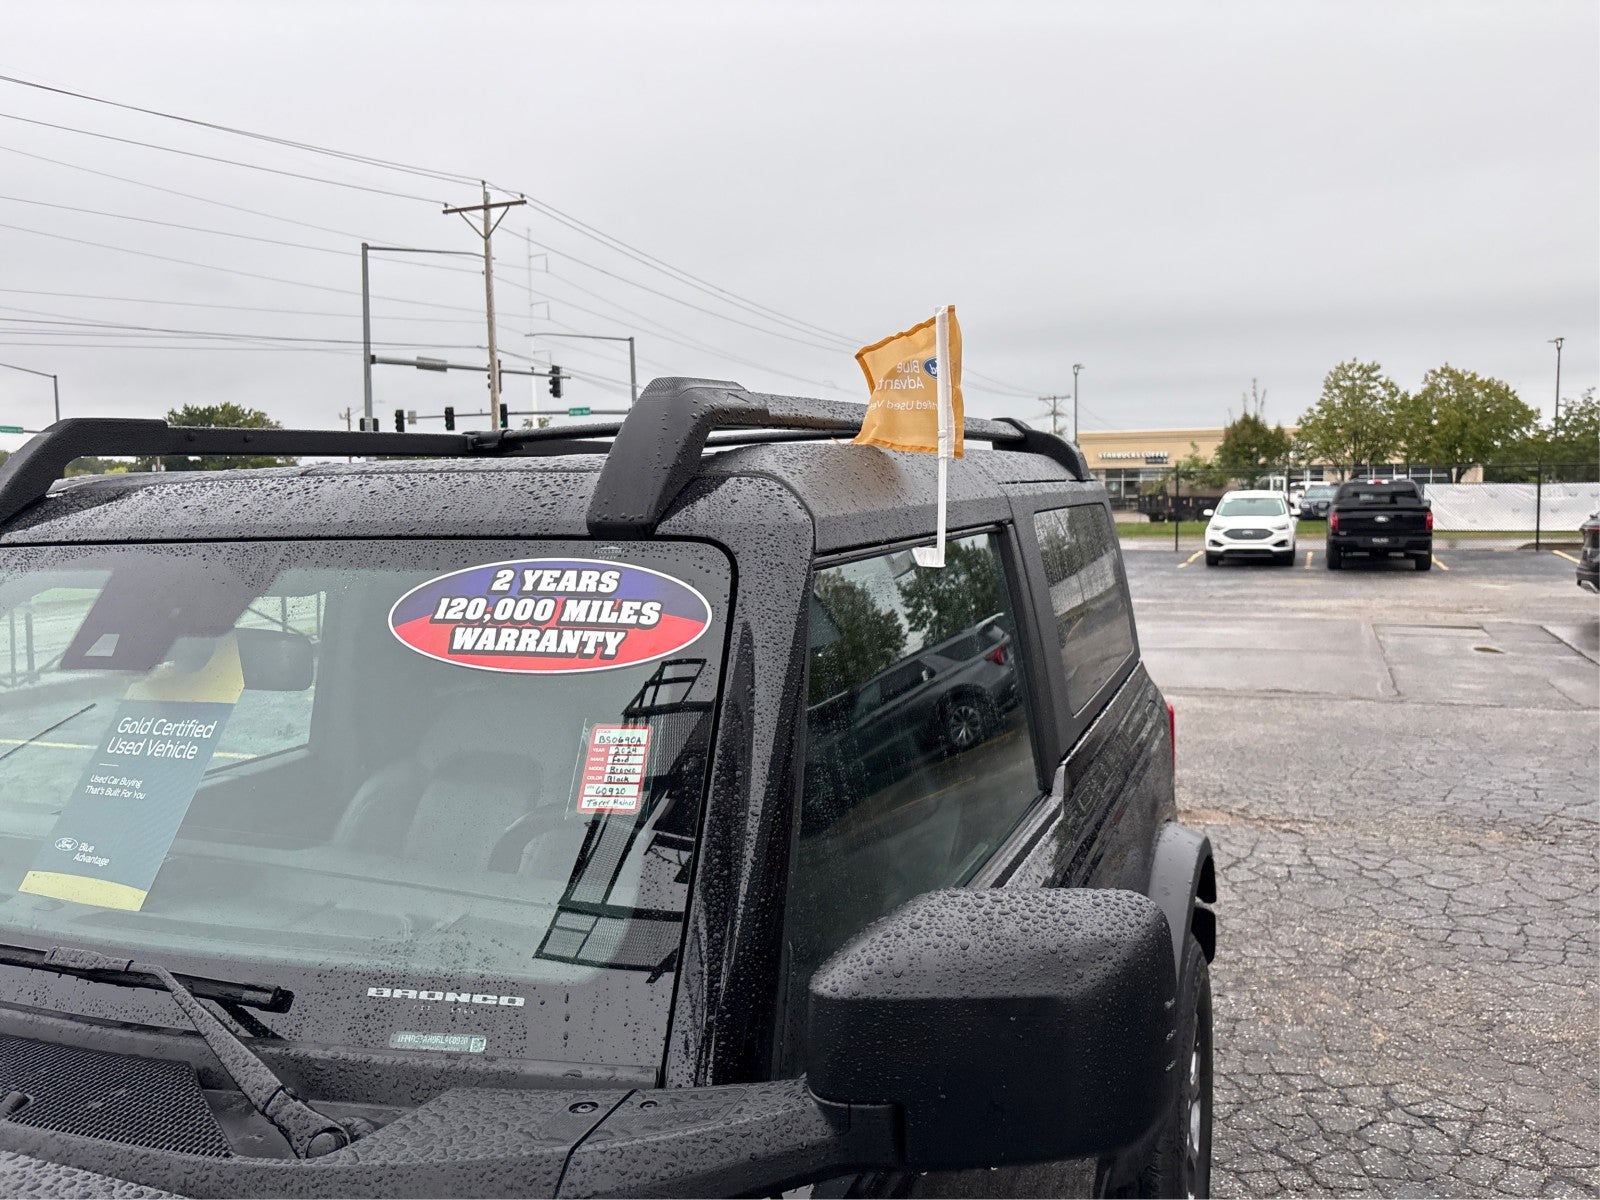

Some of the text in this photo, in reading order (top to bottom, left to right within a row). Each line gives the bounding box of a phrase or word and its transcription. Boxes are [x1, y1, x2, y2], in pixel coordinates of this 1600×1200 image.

[490, 569, 621, 593] 2 YEARS
[433, 598, 662, 626] 120,000 MILES
[451, 627, 626, 655] WARRANTY
[117, 717, 218, 739] Gold Certified
[106, 737, 199, 760] Used Vehicle
[614, 746, 637, 755] 2024
[612, 755, 630, 763] Ford
[90, 774, 143, 790] Used Car Buying
[606, 775, 630, 783] Black
[85, 785, 146, 800] That's Built For You
[595, 787, 627, 796] 60920
[79, 842, 95, 853] Blue
[72, 852, 110, 867] Advantage
[366, 987, 525, 1007] BRONCO
